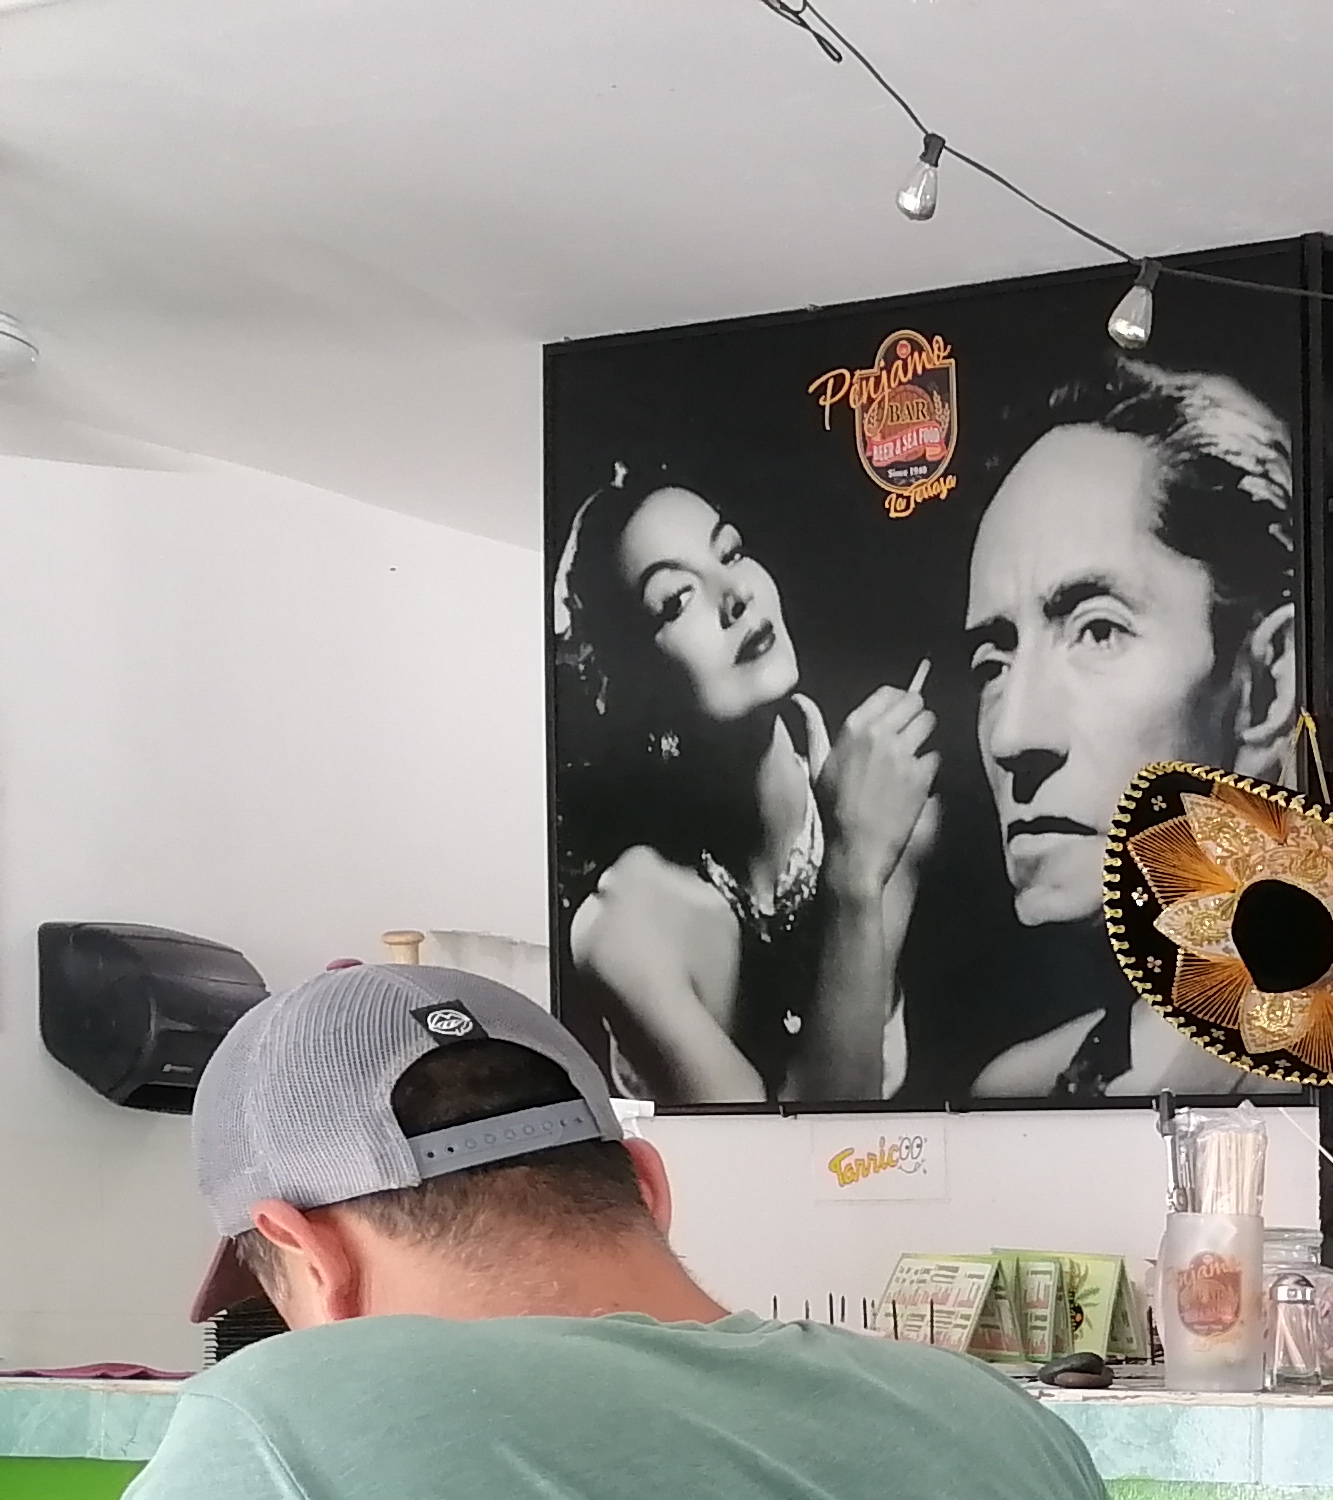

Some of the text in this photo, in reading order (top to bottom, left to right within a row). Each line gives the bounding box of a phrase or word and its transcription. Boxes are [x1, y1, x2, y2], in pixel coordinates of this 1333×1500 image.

[888, 400, 931, 424] BAR
[872, 442, 895, 462] BEER
[902, 432, 919, 452] SEA
[920, 428, 941, 446] FOOD
